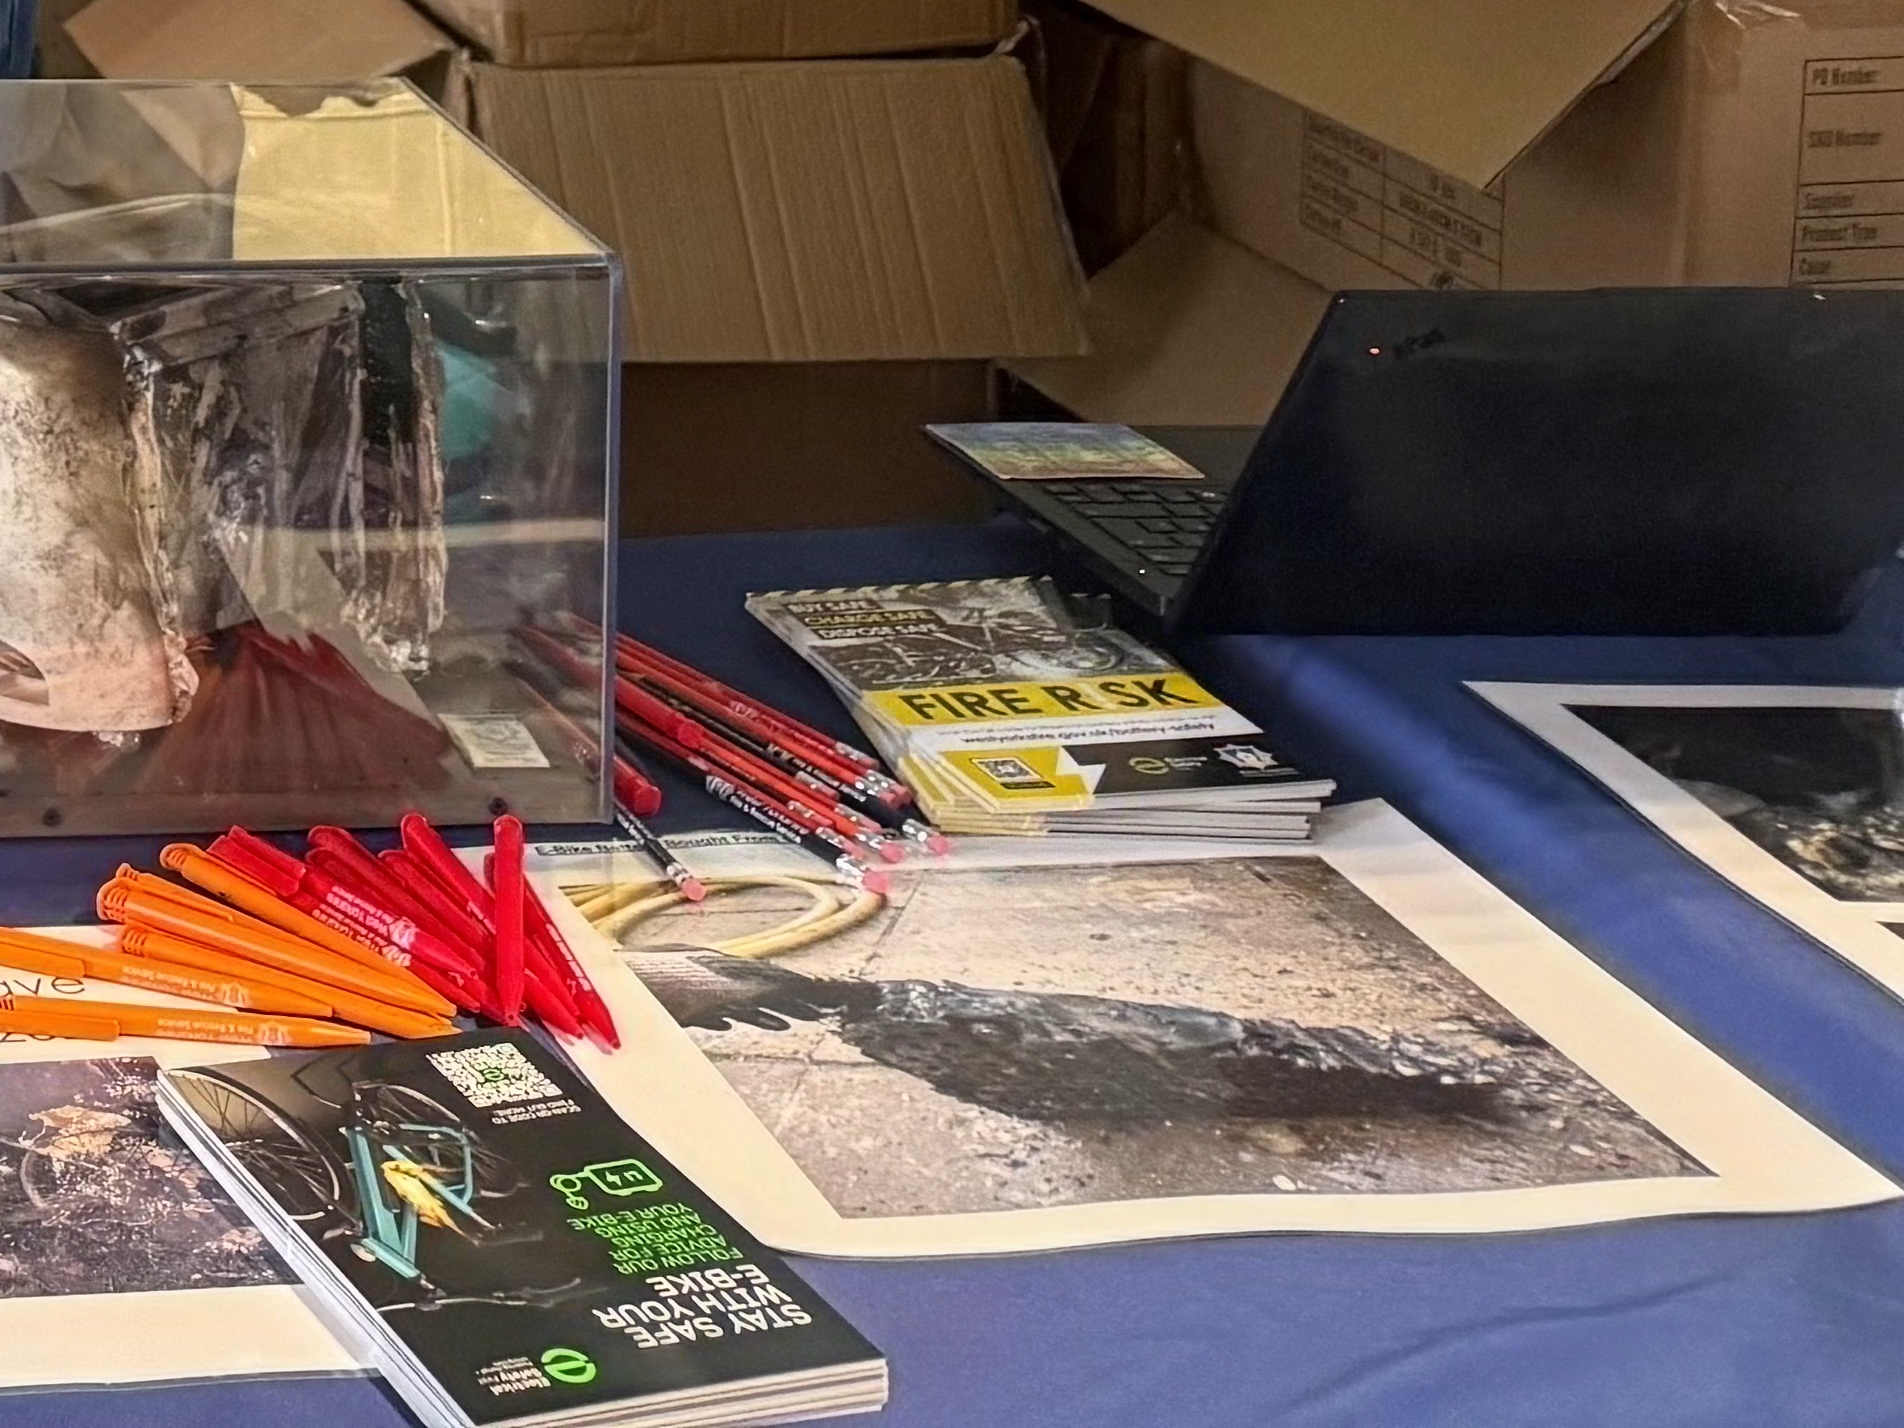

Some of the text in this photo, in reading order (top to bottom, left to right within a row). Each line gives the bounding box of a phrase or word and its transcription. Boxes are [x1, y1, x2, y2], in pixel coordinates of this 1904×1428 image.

[804, 611, 874, 627] CHARGE
[818, 624, 893, 639] DISPOSE
[898, 687, 1043, 721] FIRE
[566, 1202, 694, 1231] YOUR E-BIKE
[595, 1213, 702, 1240] AND USING
[608, 1234, 728, 1263] ADVICE FOR
[611, 1224, 718, 1249] CHARGING
[612, 1246, 745, 1275] FOLLOW OUR
[645, 1263, 770, 1299] E-BIKE
[592, 1285, 794, 1330] WITH YOUR
[624, 1304, 813, 1350] STAY SAFE
